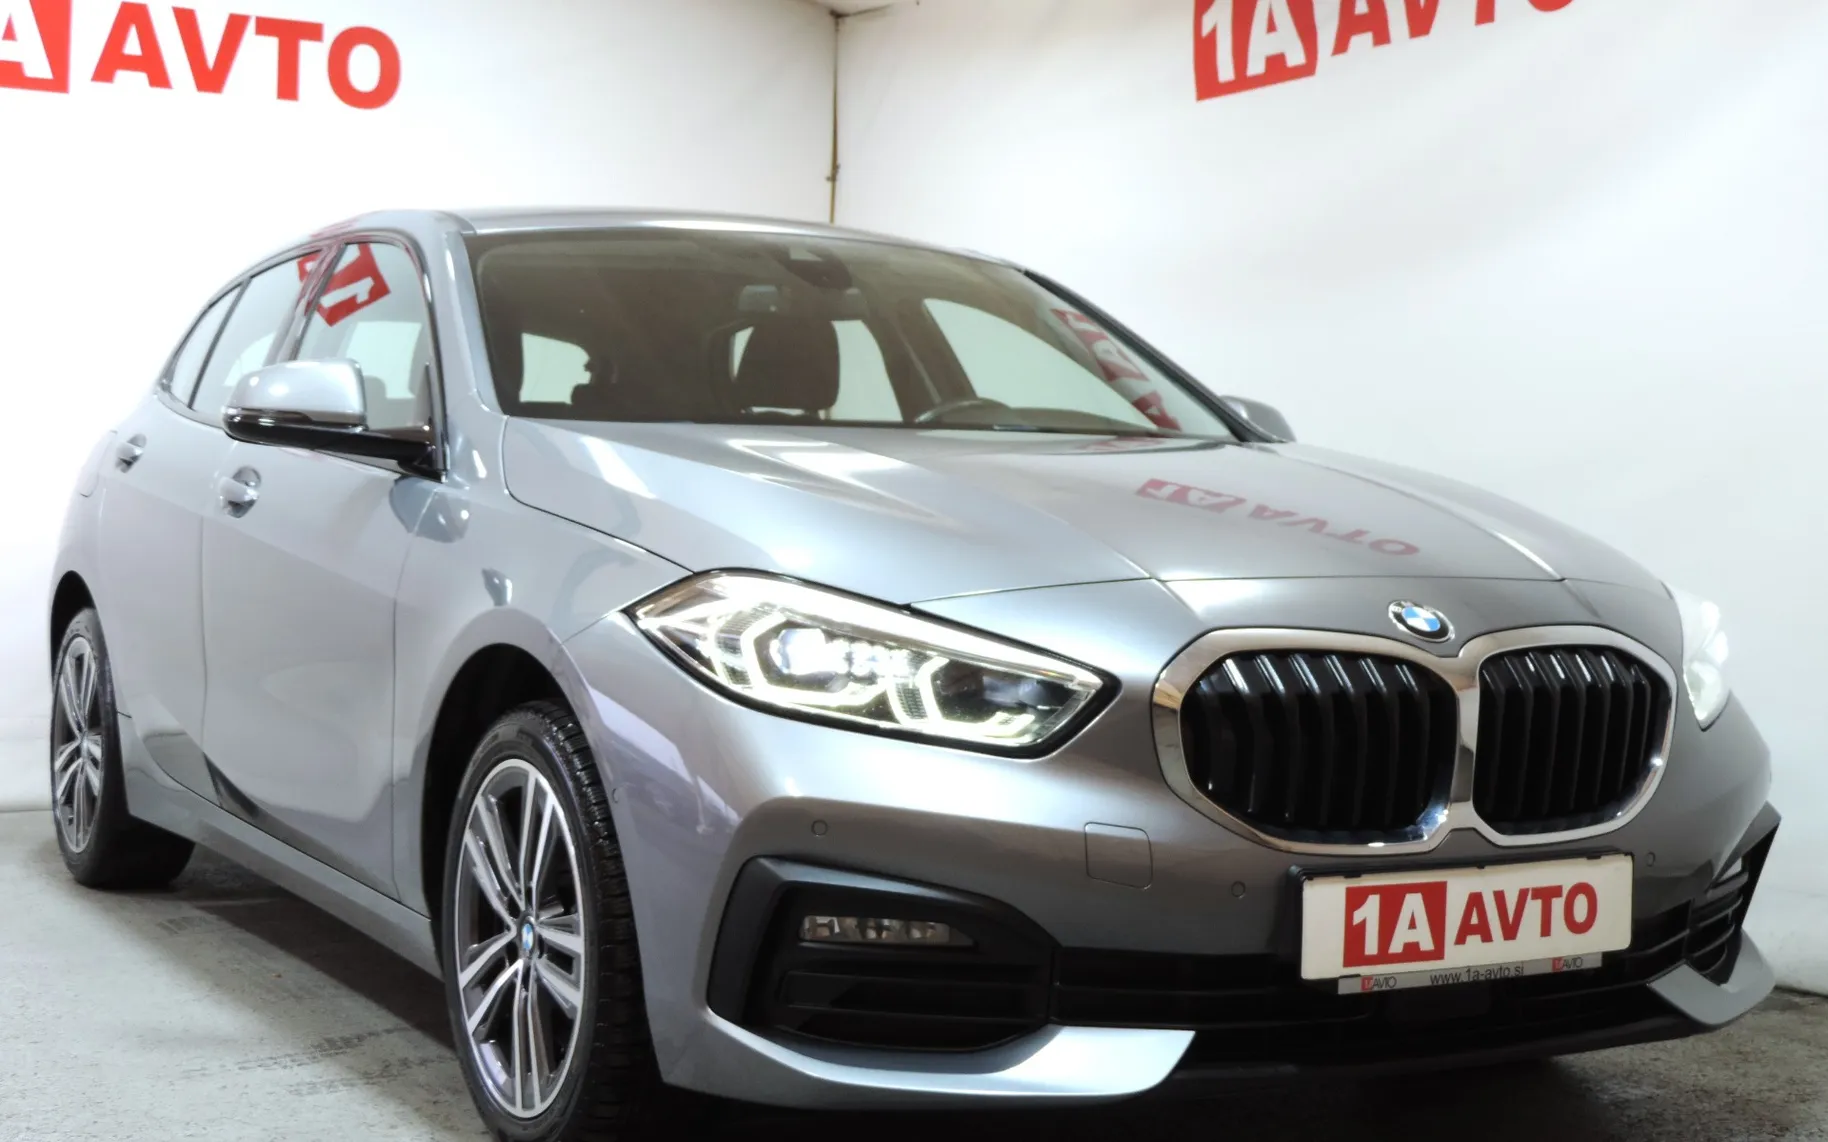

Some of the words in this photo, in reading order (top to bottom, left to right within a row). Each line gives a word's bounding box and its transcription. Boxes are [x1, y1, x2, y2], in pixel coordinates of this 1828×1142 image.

[0, 0, 54, 79] A
[91, 1, 401, 110] AVTO
[1200, 0, 1307, 84] 1A
[1352, 892, 1435, 956] 1A
[1453, 881, 1598, 946] AVTO
[1429, 961, 1525, 985] www.1a-avto.si
